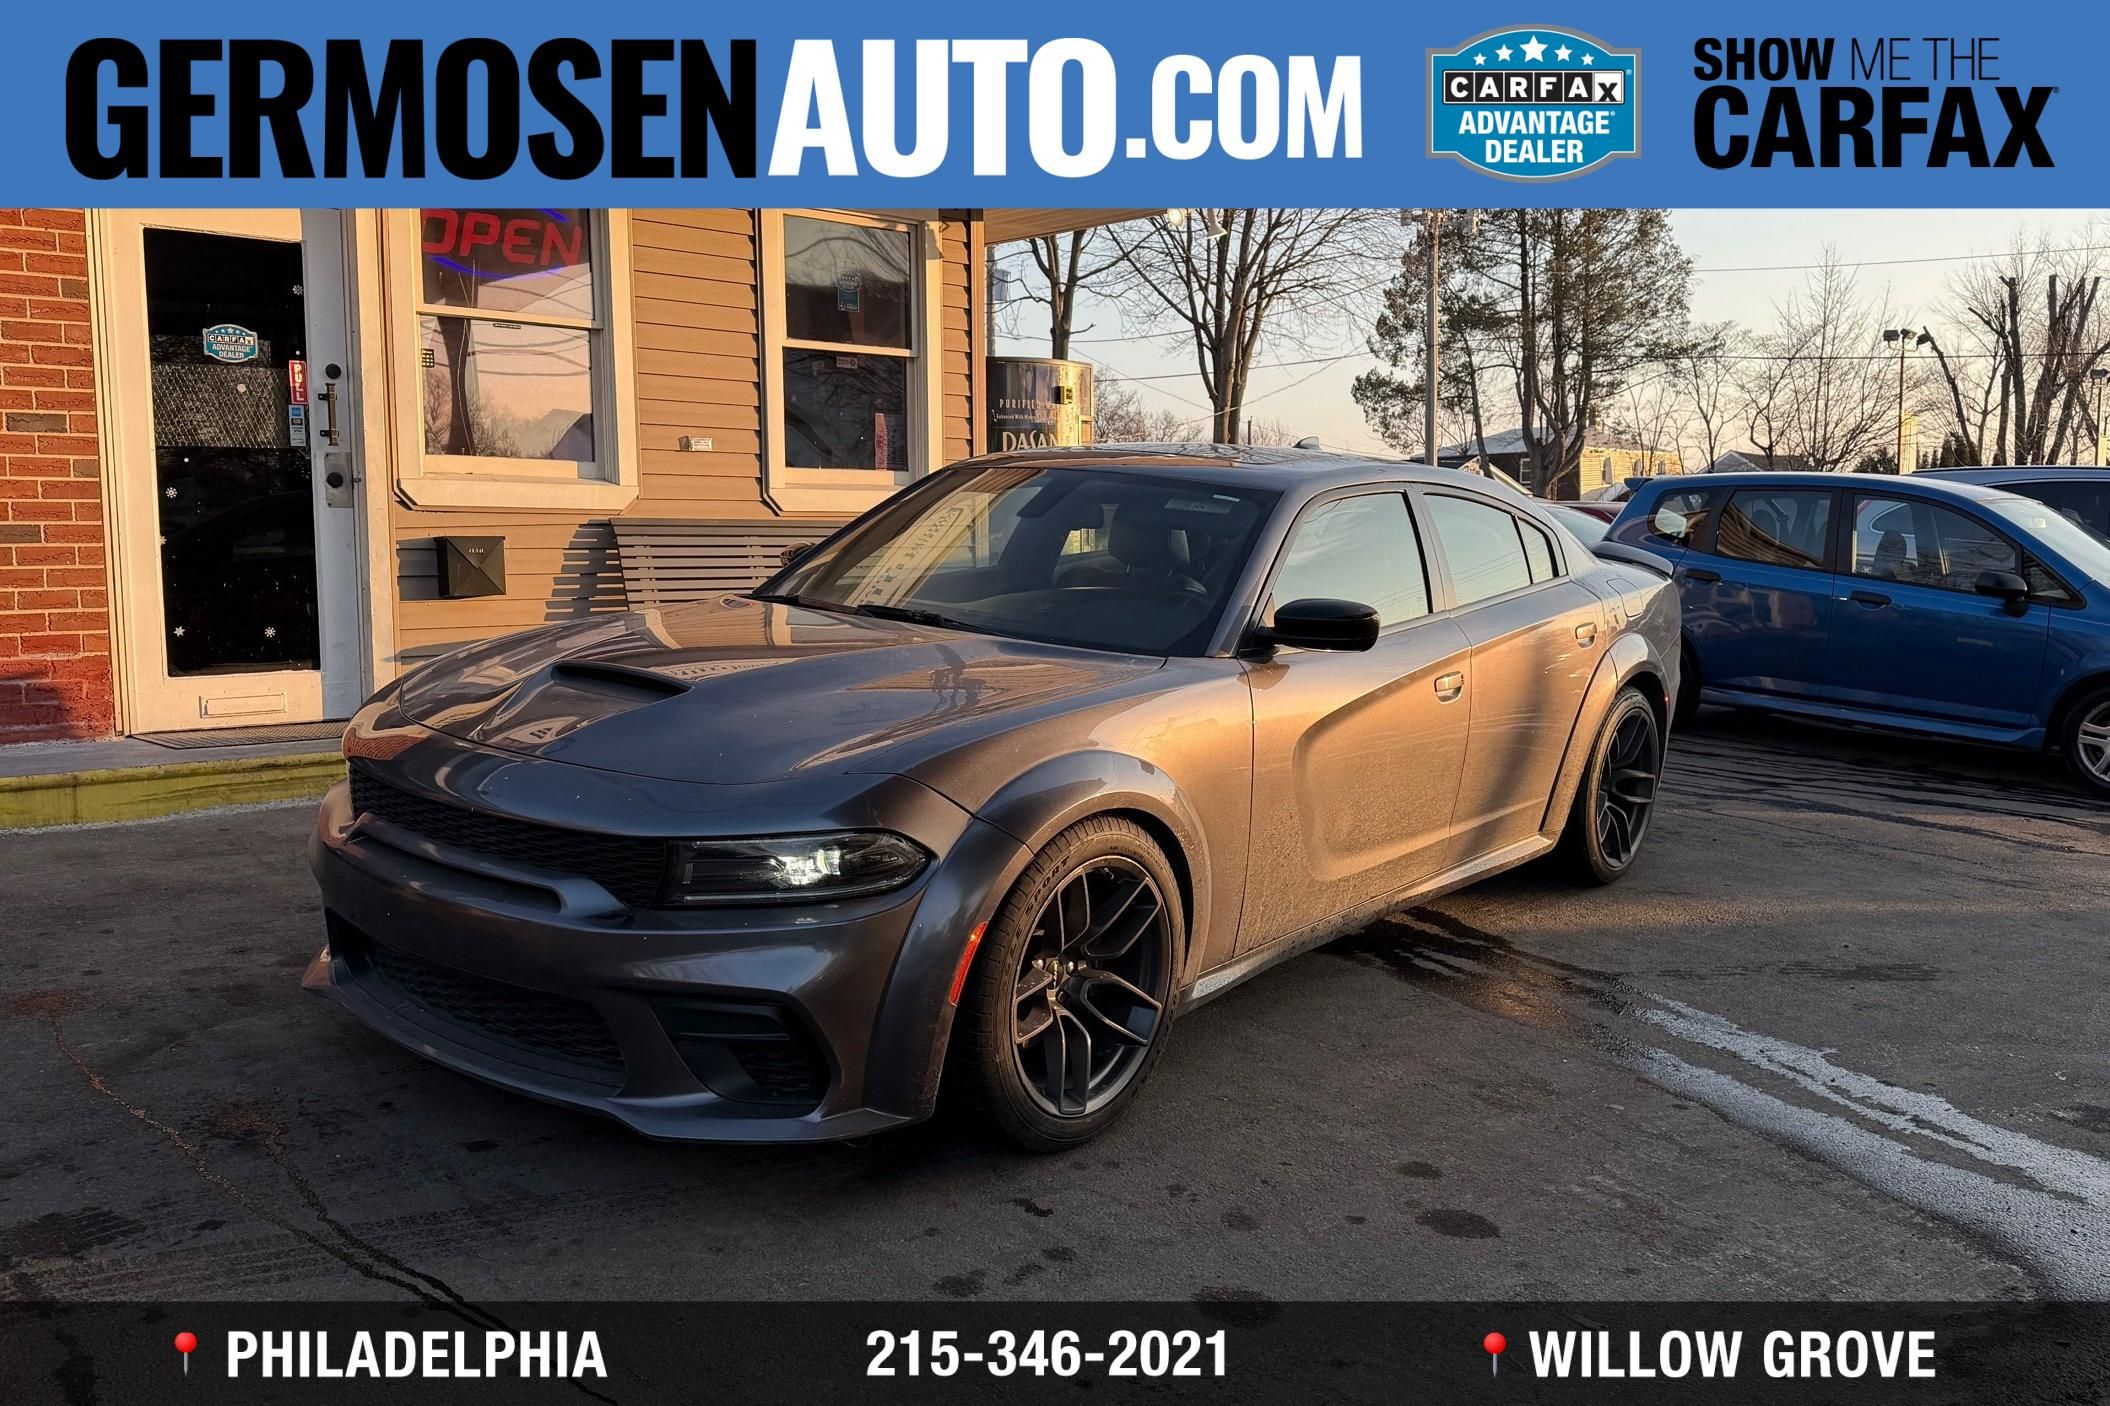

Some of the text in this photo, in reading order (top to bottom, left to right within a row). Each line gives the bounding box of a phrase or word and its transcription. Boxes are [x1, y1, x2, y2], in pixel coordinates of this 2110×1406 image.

[421, 208, 583, 267] OPEN
[209, 335, 254, 346] CARFAX
[212, 343, 251, 353] ADVANTAGE
[218, 350, 245, 359] DEALER
[293, 363, 305, 401] PULL
[999, 398, 1041, 409] PURIFIED
[1024, 854, 1071, 917] SPORT
